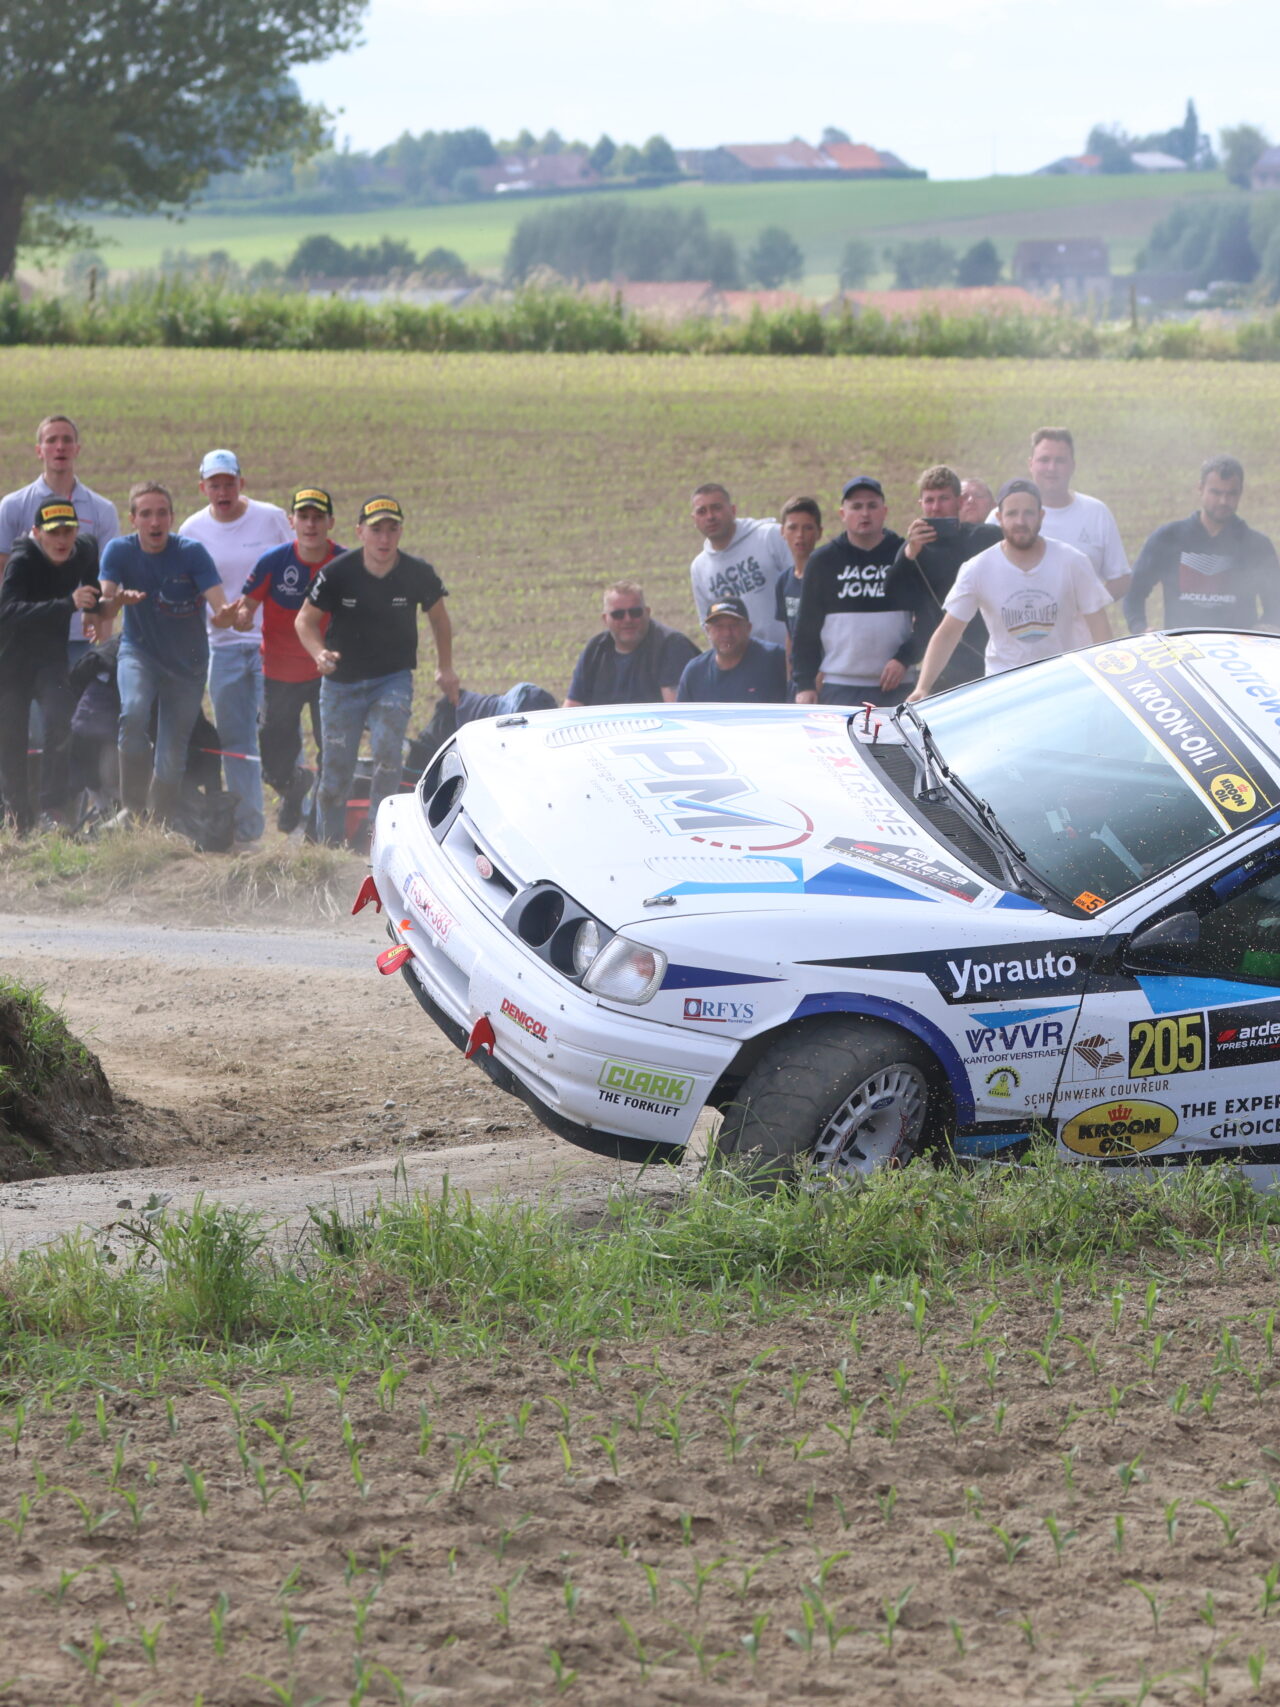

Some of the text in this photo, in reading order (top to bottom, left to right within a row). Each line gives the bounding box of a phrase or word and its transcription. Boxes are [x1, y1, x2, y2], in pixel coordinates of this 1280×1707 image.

[709, 556, 760, 593] JACK&
[1001, 602, 1057, 626] QUIKSILVER
[1127, 679, 1219, 766] KROON-OIL
[815, 745, 917, 836] EXTREME
[1214, 789, 1232, 803] OIL
[1219, 778, 1247, 807] KROON
[613, 783, 661, 834] Motorsport
[850, 846, 892, 866] YPRES
[891, 860, 930, 876] RALLY
[880, 850, 970, 886] ardeca
[1086, 898, 1102, 911] 5
[946, 950, 1077, 999] Yprauto
[685, 999, 754, 1019] ORFYS
[963, 1048, 1068, 1065] KANTOOR VERSTRAETE
[1130, 1015, 1203, 1079] 205
[1216, 1040, 1248, 1051] YPRES
[1249, 1035, 1280, 1048] RALLY
[605, 1064, 687, 1101] CLARK
[1110, 1079, 1170, 1097] COUVREUR
[598, 1090, 681, 1117] THE FORKLIFT
[1180, 1101, 1217, 1119] THE
[1078, 1117, 1161, 1140] KROON
[1098, 1136, 1135, 1154] OIL
